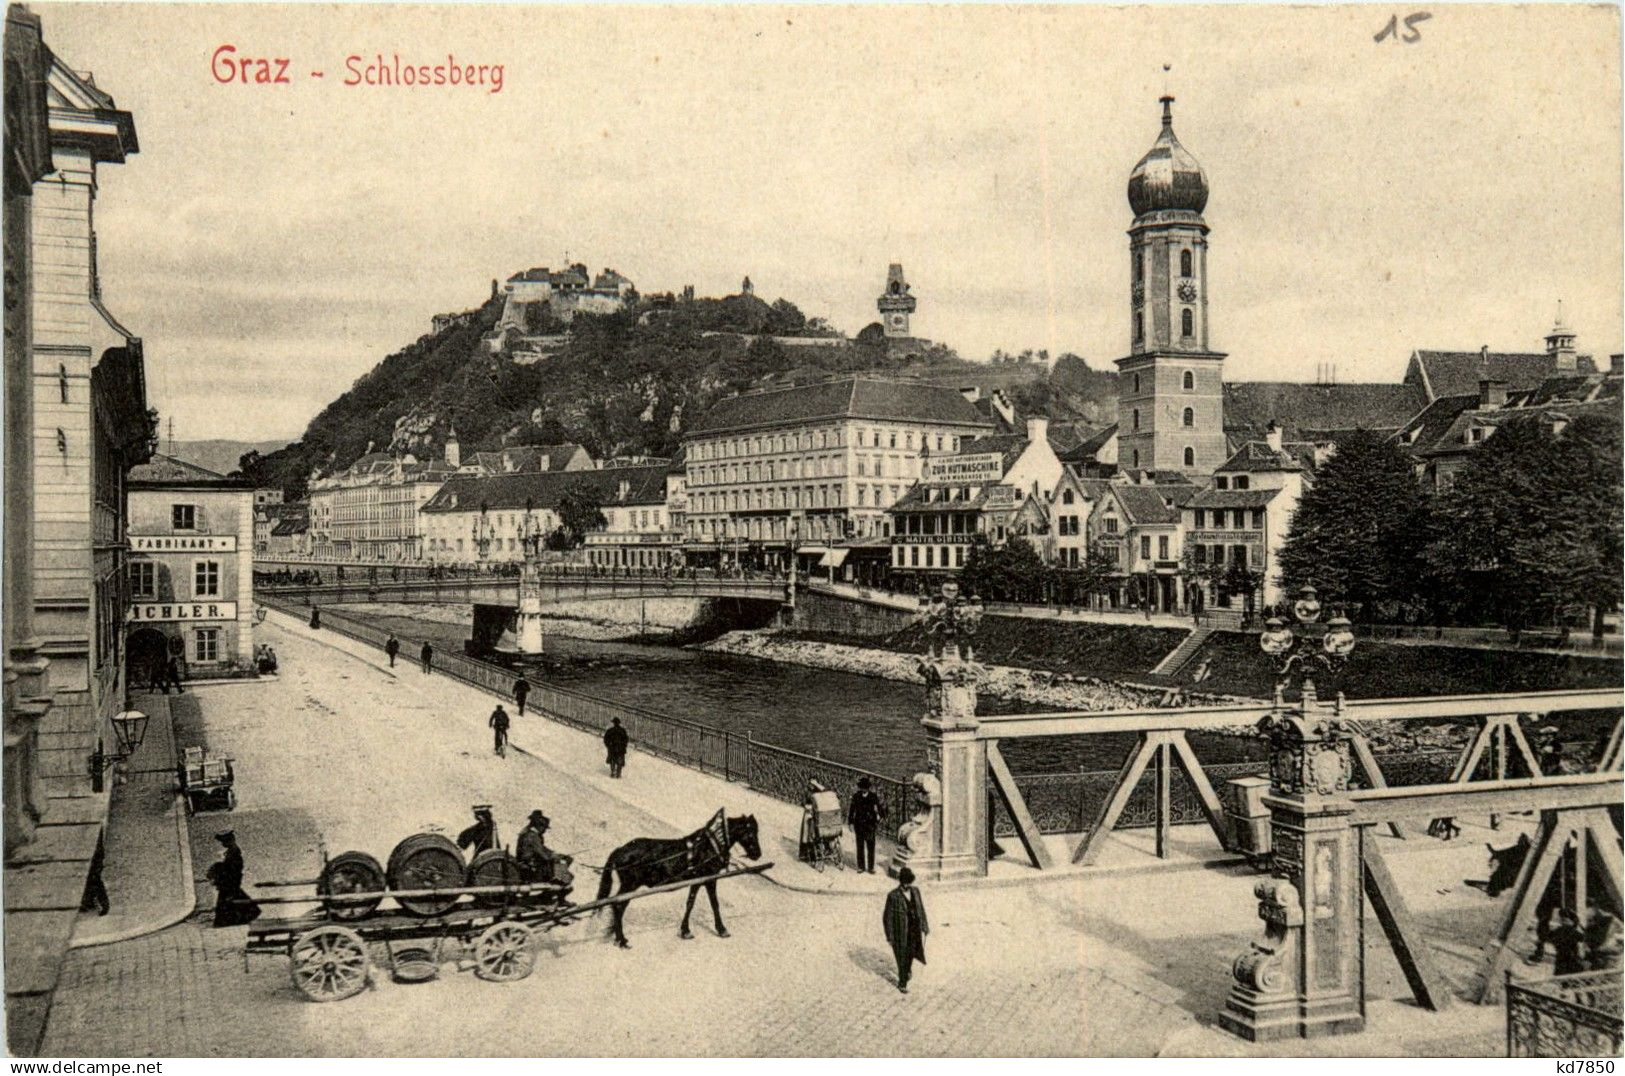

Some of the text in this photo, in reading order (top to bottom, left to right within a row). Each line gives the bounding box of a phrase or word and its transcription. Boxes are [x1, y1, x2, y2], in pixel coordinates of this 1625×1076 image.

[1373, 11, 1433, 43] 15
[948, 461, 998, 474] HUTMASCHINE
[138, 538, 214, 549] FABRIKANT
